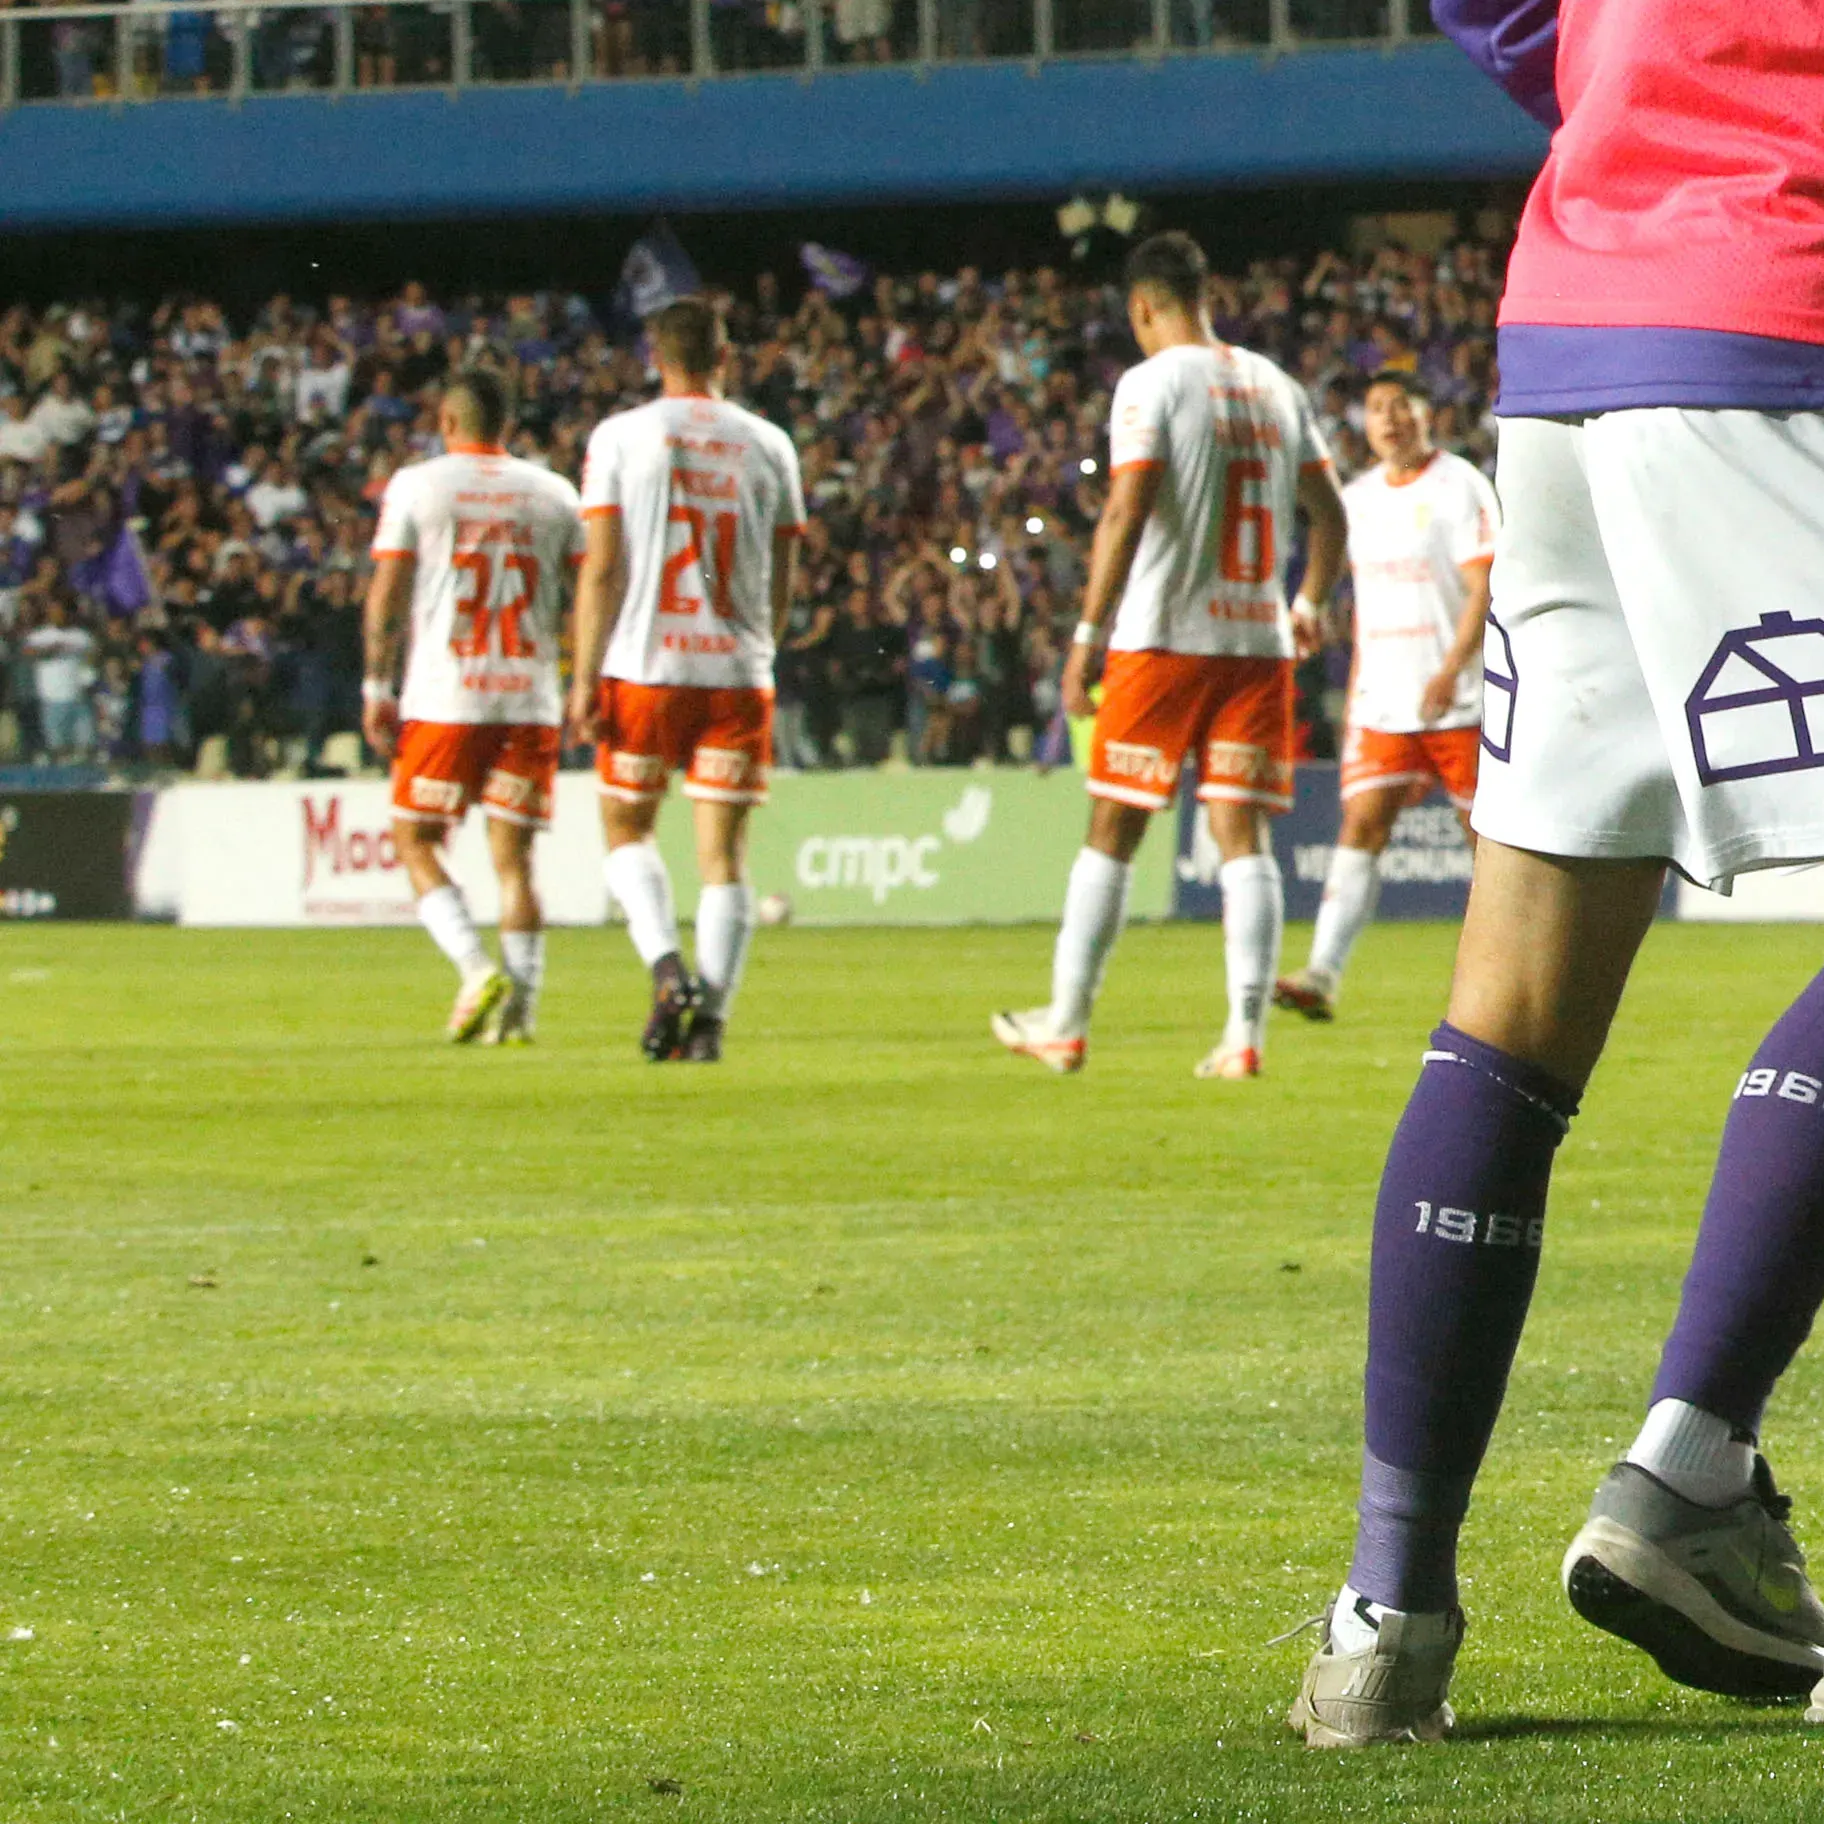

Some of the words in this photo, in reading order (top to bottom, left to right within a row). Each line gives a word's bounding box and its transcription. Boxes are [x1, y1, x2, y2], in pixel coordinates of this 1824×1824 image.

[658, 505, 739, 617] 21
[1219, 459, 1275, 584] 6
[450, 552, 540, 659] 32
[796, 833, 942, 906] cmpc
[1414, 1199, 1545, 1247] 1966
